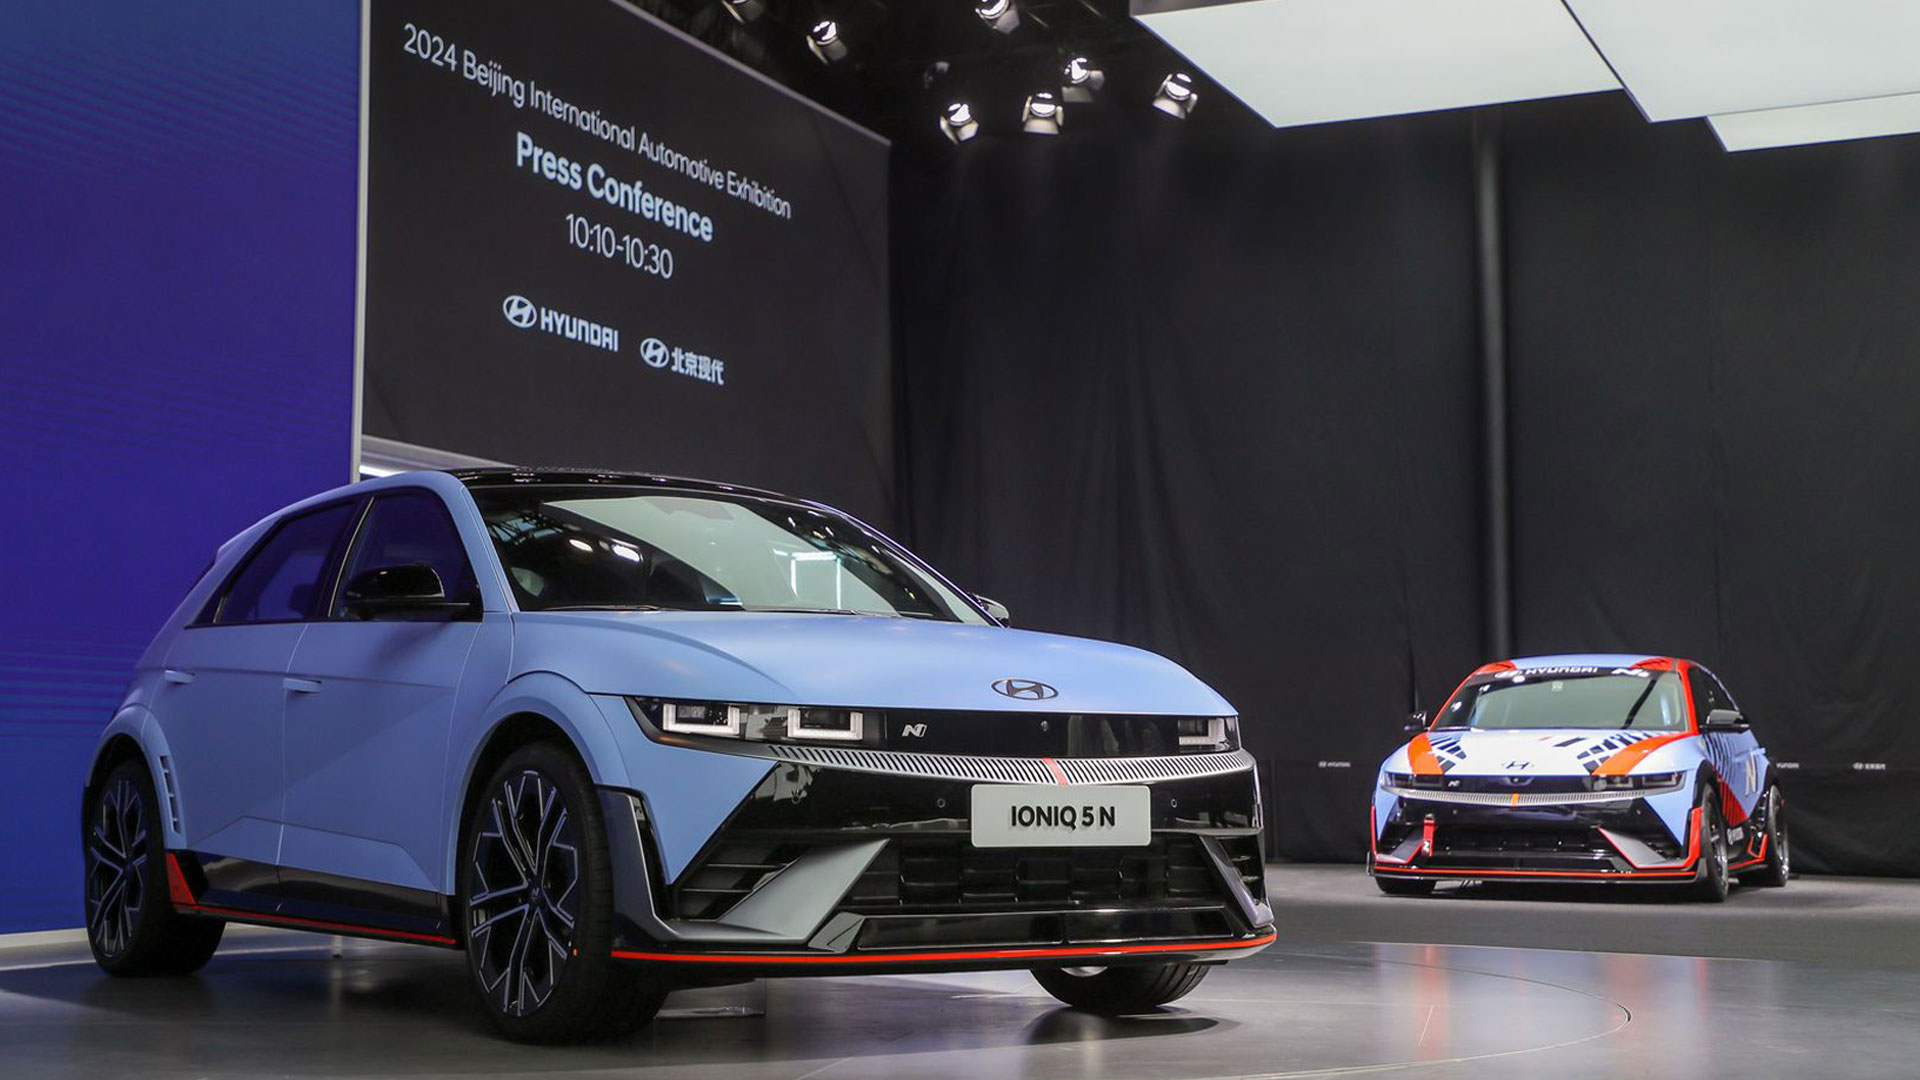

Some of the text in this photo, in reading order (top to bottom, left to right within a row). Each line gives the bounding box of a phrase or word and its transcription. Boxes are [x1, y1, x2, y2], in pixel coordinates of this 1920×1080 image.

[403, 22, 792, 220] 2024 Beijing International Automotive Exhibition
[516, 131, 714, 242] Press Conference
[565, 213, 674, 279] 10:10-10:30
[540, 306, 619, 353] HYUNDAI
[670, 346, 725, 386] 北京现代
[1525, 667, 1599, 675] HYUNDAI
[1011, 805, 1115, 830] IONIQ 5 N
